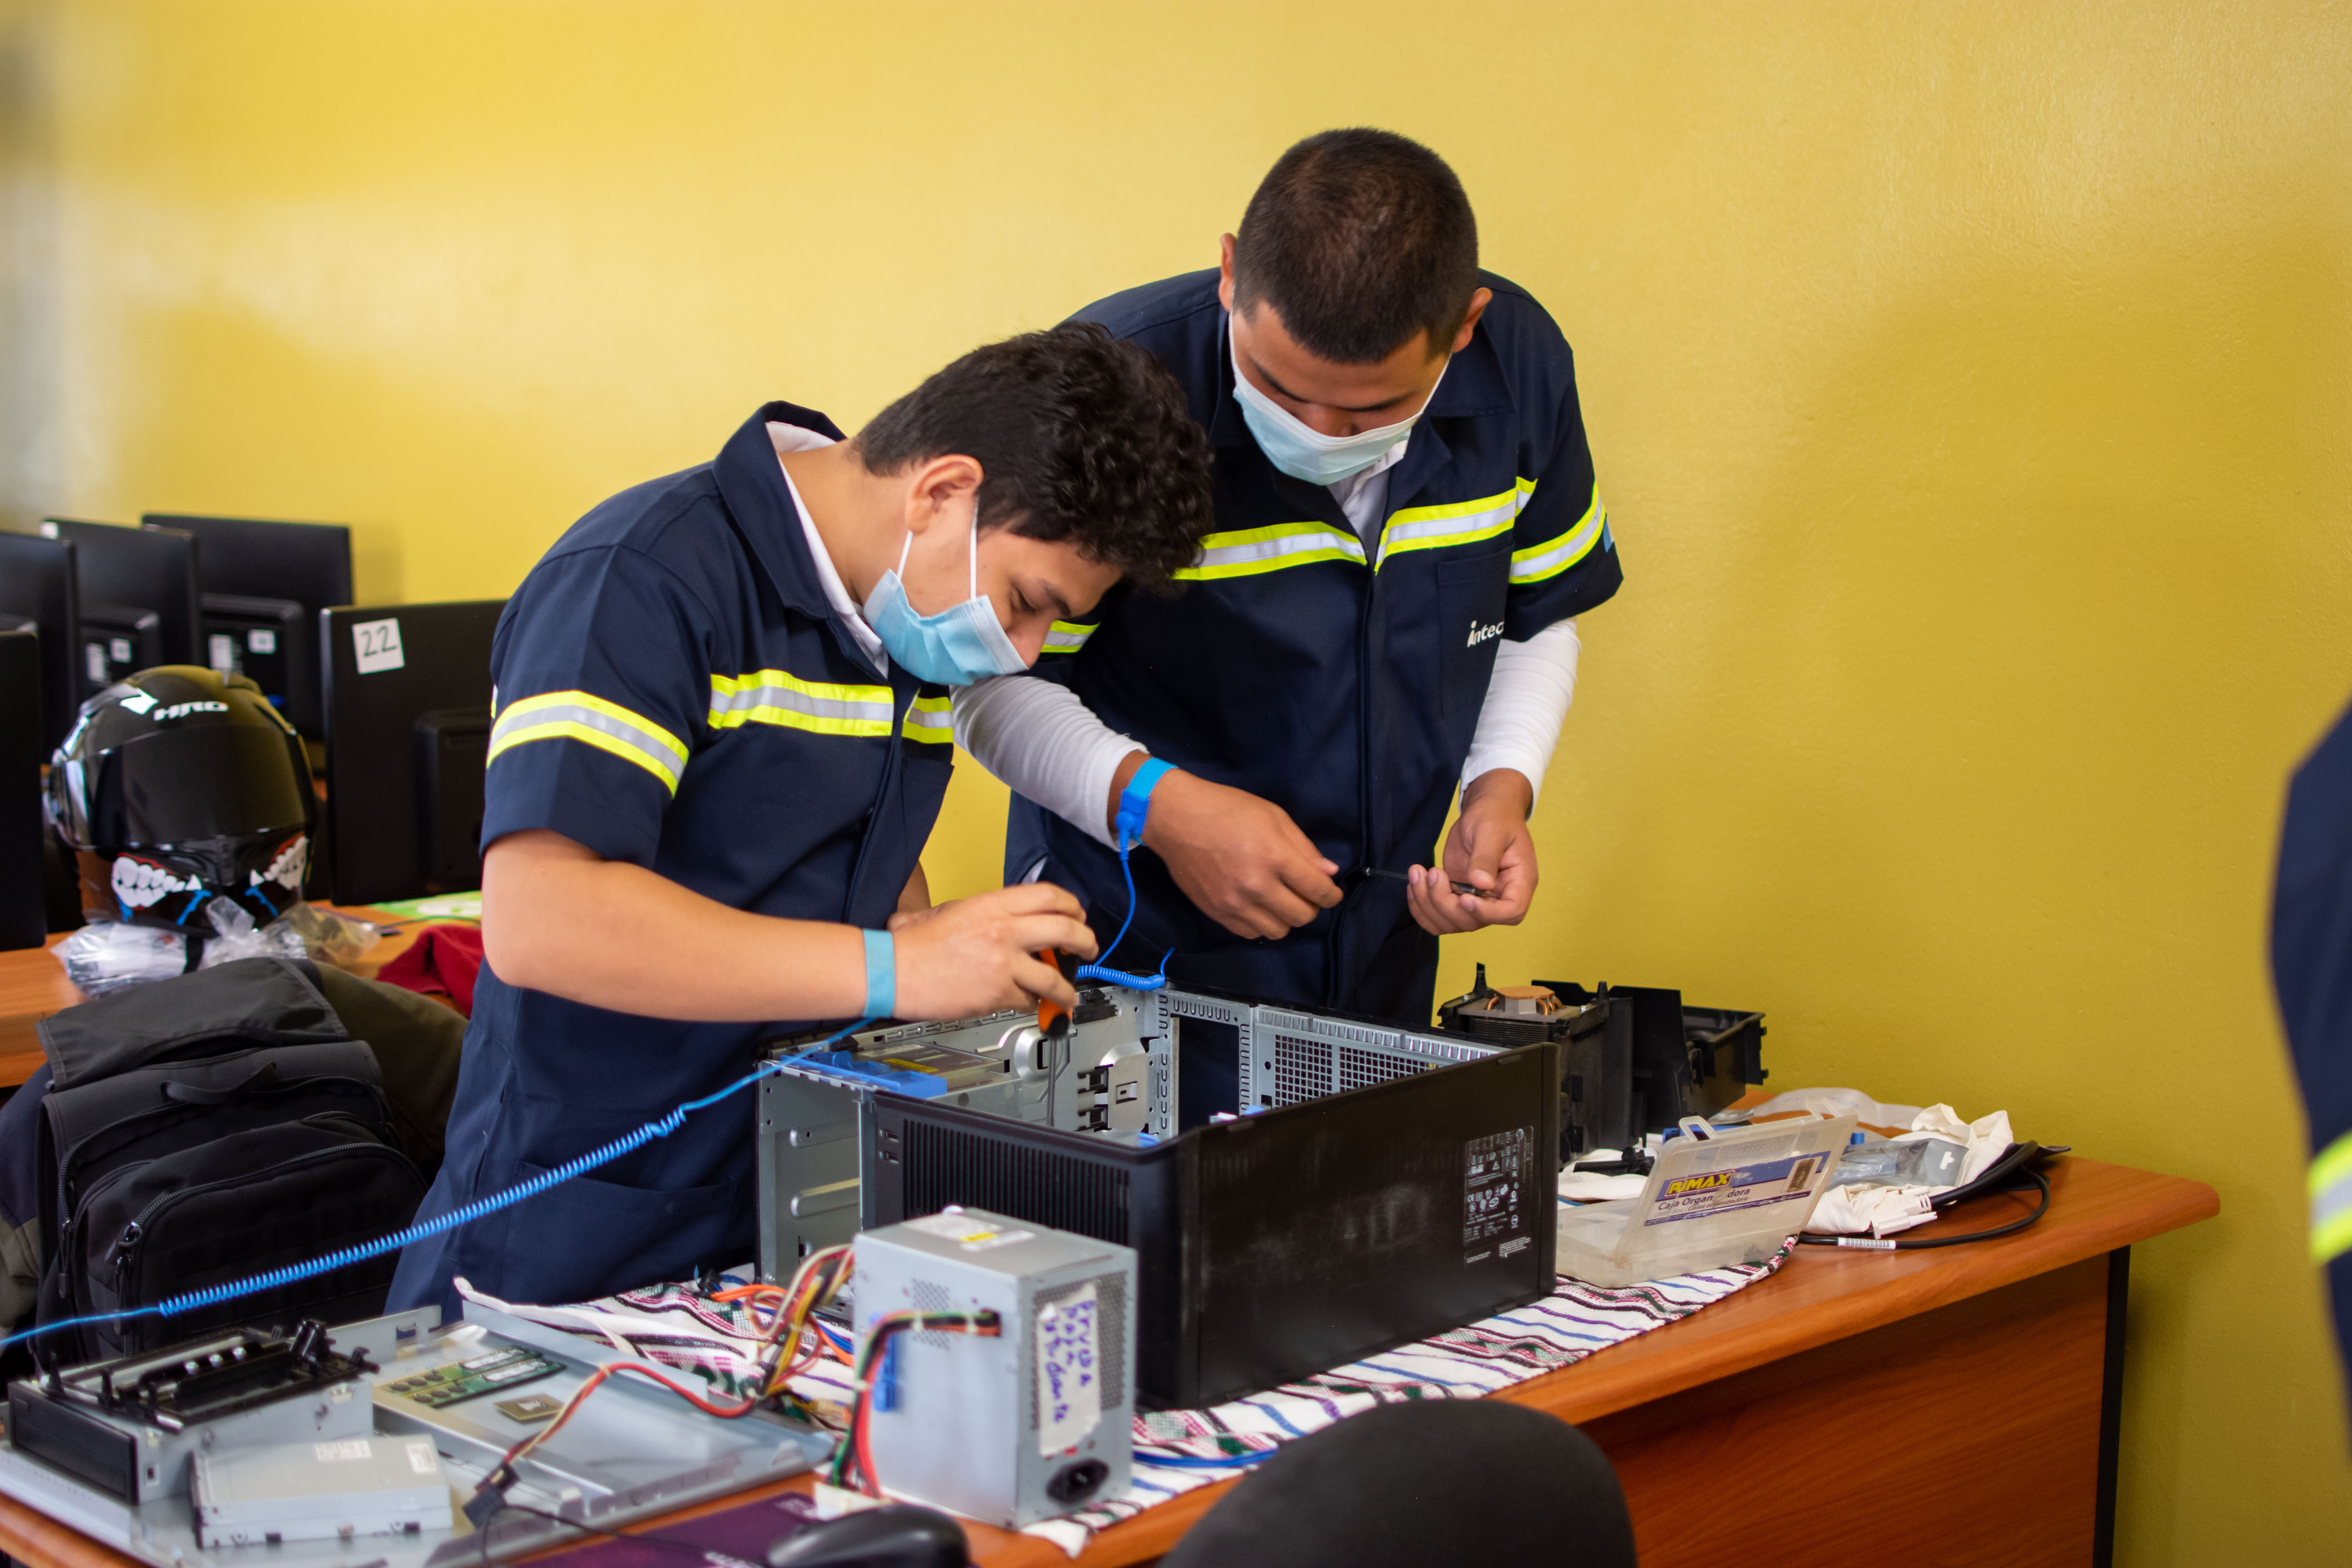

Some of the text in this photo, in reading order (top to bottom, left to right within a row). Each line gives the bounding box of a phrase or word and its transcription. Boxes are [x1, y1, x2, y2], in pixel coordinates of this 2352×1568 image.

[361, 625, 397, 657] 22
[1668, 1172, 1732, 1194] RIMAX
[1658, 1189, 1750, 1210] Caja Organdora
